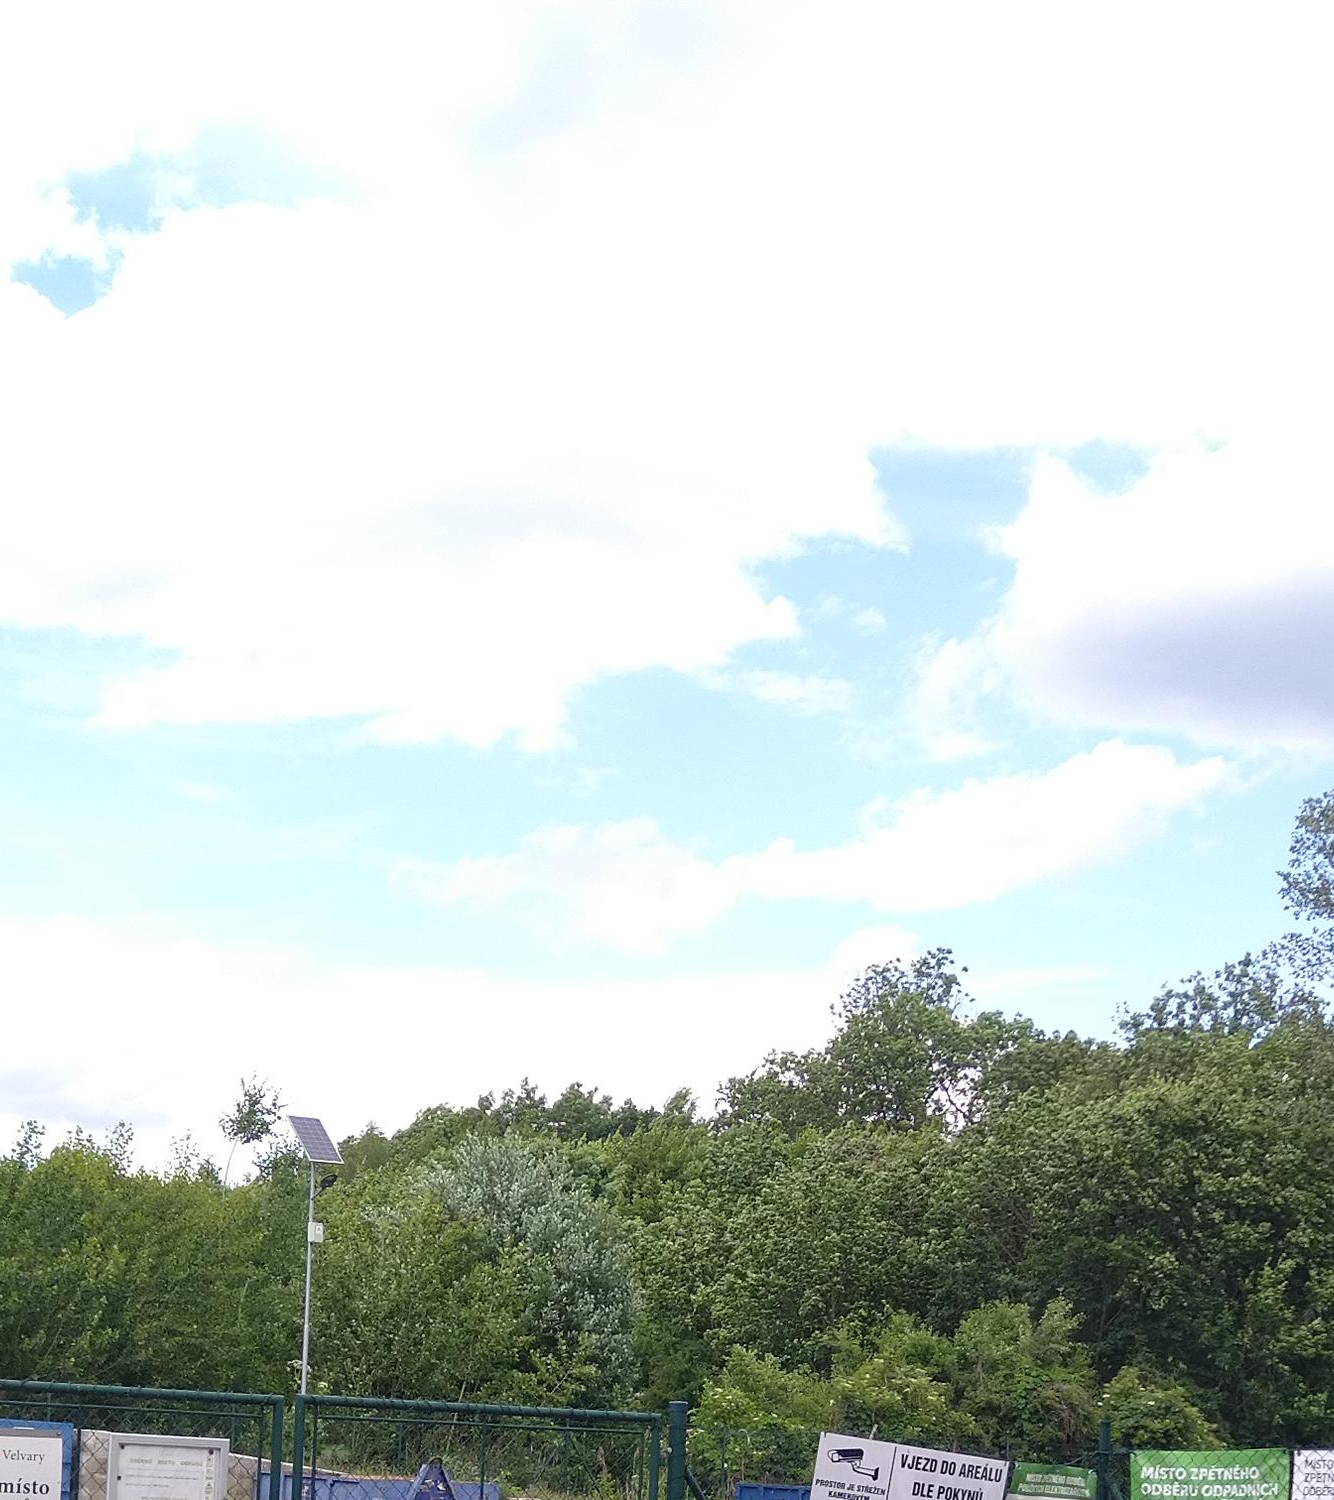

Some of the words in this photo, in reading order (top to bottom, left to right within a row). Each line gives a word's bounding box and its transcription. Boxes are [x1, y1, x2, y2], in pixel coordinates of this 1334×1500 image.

[2, 1449, 45, 1465] Velvary
[901, 1453, 937, 1474] VJEZD
[940, 1458, 956, 1476] DO
[958, 1461, 1003, 1483] AREÁLU
[1141, 1465, 1187, 1480] MÍSTO
[1190, 1465, 1260, 1480] ZPĚTNÉHO
[815, 1478, 846, 1491] PROSTOR
[846, 1483, 856, 1492] JE
[856, 1484, 886, 1496] STŘEŽEN
[912, 1481, 936, 1499] DLE
[1141, 1482, 1198, 1496] ODBĚRU
[1201, 1482, 1278, 1497] ODPADNÍCH
